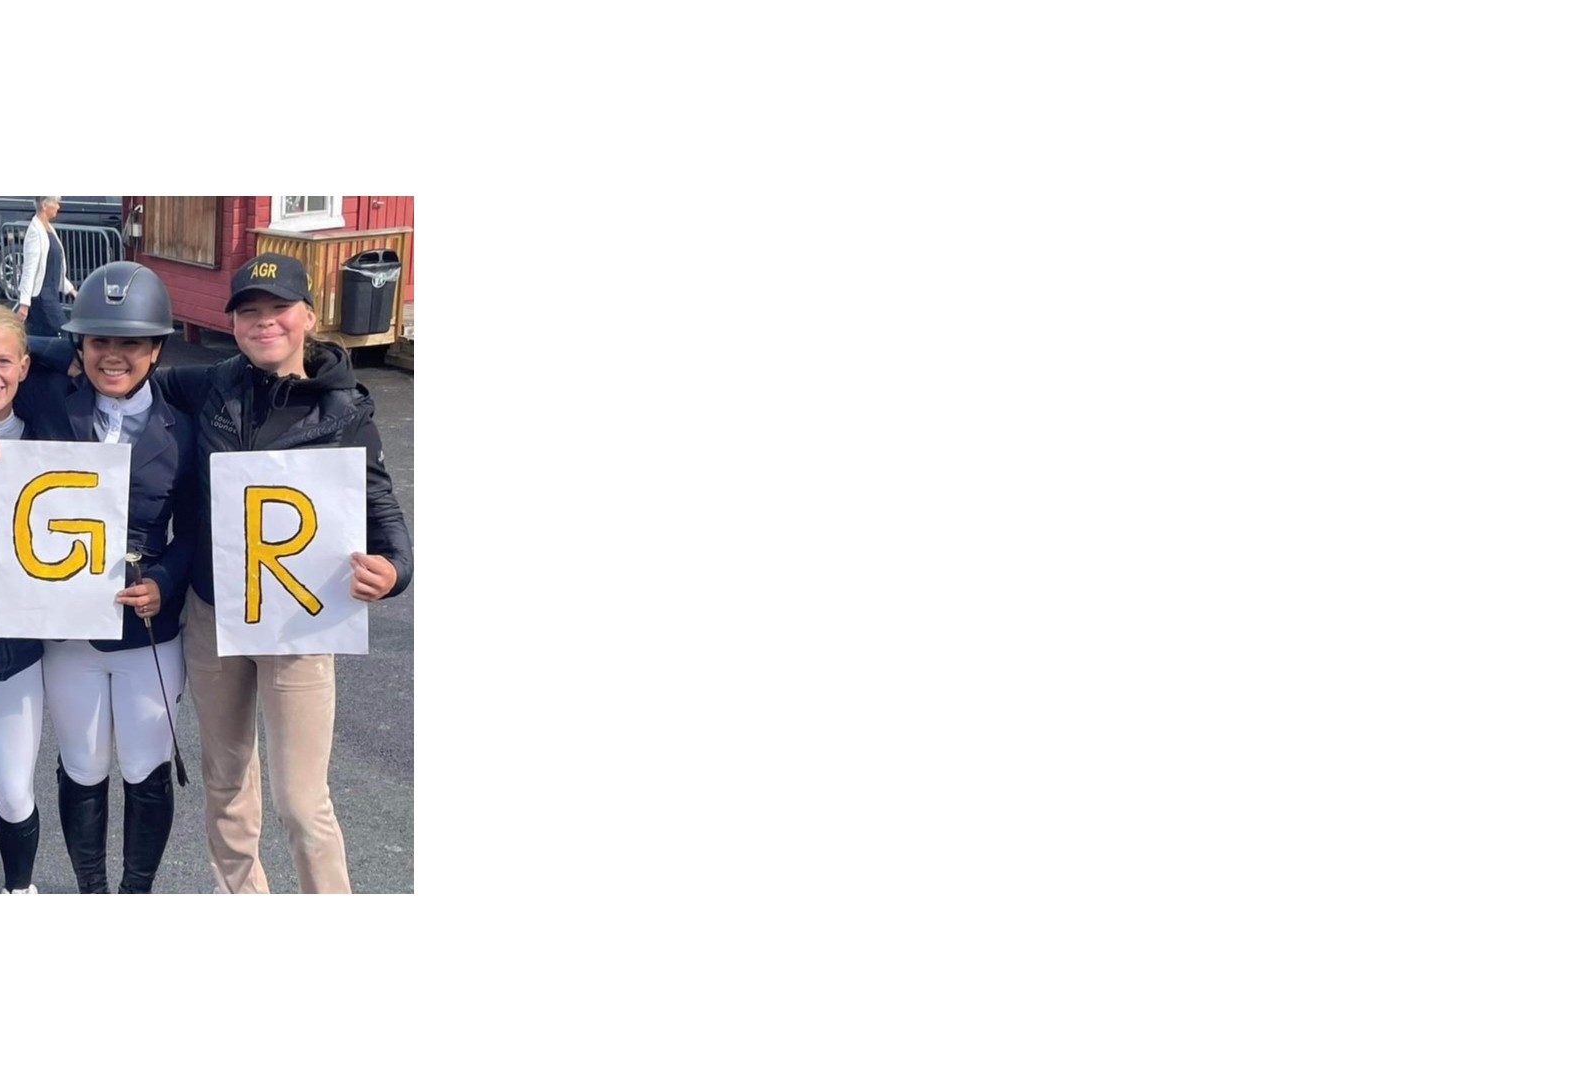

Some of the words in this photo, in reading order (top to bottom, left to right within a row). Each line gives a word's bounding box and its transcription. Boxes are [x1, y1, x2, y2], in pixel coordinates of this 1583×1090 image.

[250, 262, 278, 280] AGR
[12, 470, 106, 580] G
[243, 485, 323, 624] R
